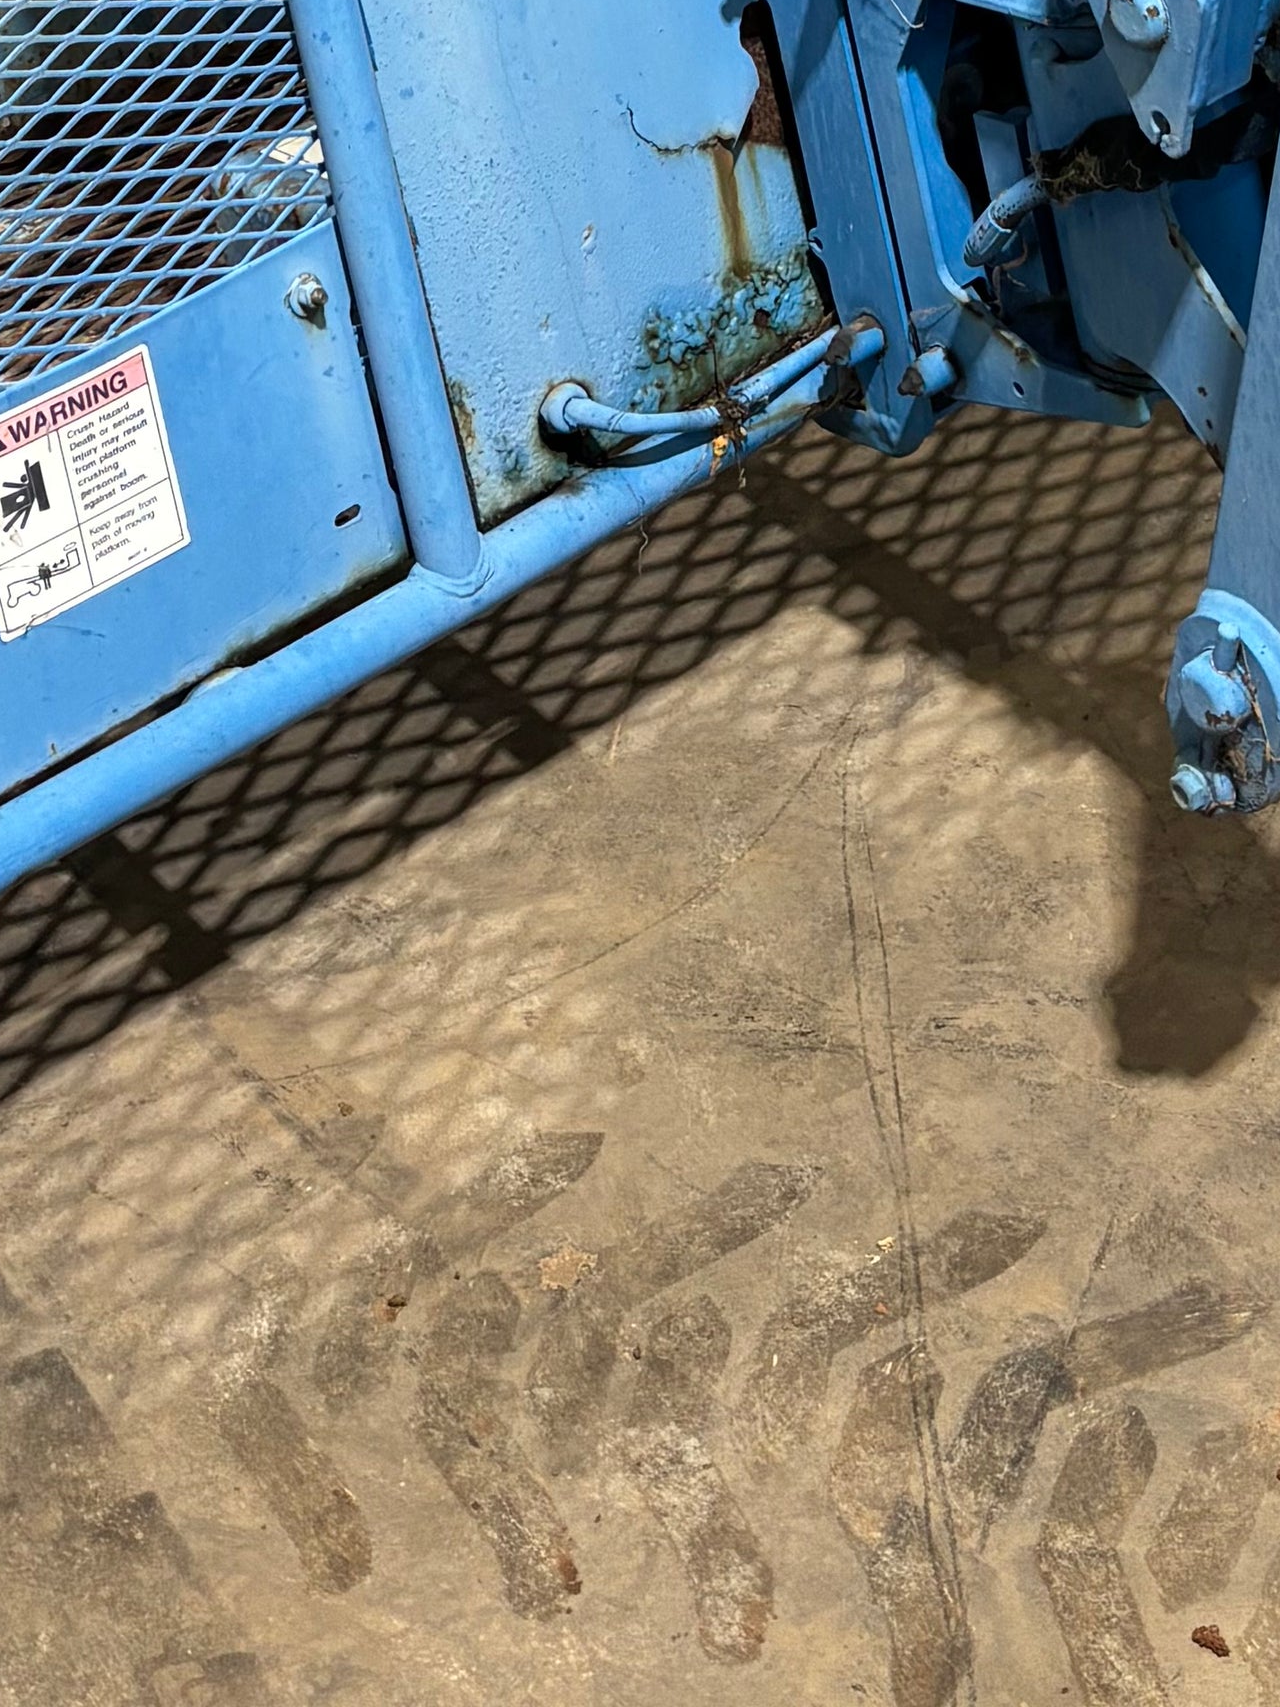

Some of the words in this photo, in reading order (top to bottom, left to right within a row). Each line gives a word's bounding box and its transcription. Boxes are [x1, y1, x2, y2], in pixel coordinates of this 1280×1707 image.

[8, 370, 128, 442] WARNING
[67, 421, 95, 439] Crush
[99, 401, 130, 423] Hazard
[69, 433, 96, 451] Death
[99, 427, 108, 436] or
[112, 408, 145, 429] serious
[101, 435, 119, 448] may
[123, 419, 148, 437] result
[75, 460, 96, 475] from
[99, 439, 136, 464] platform
[78, 461, 119, 487] crushing
[81, 468, 127, 500] personnel
[84, 488, 116, 510] against
[120, 473, 148, 491] boom.
[89, 521, 111, 536] Keep
[115, 508, 135, 523] away
[138, 496, 158, 510] from
[92, 534, 111, 550] path
[114, 526, 122, 536] of
[125, 511, 155, 530] moving
